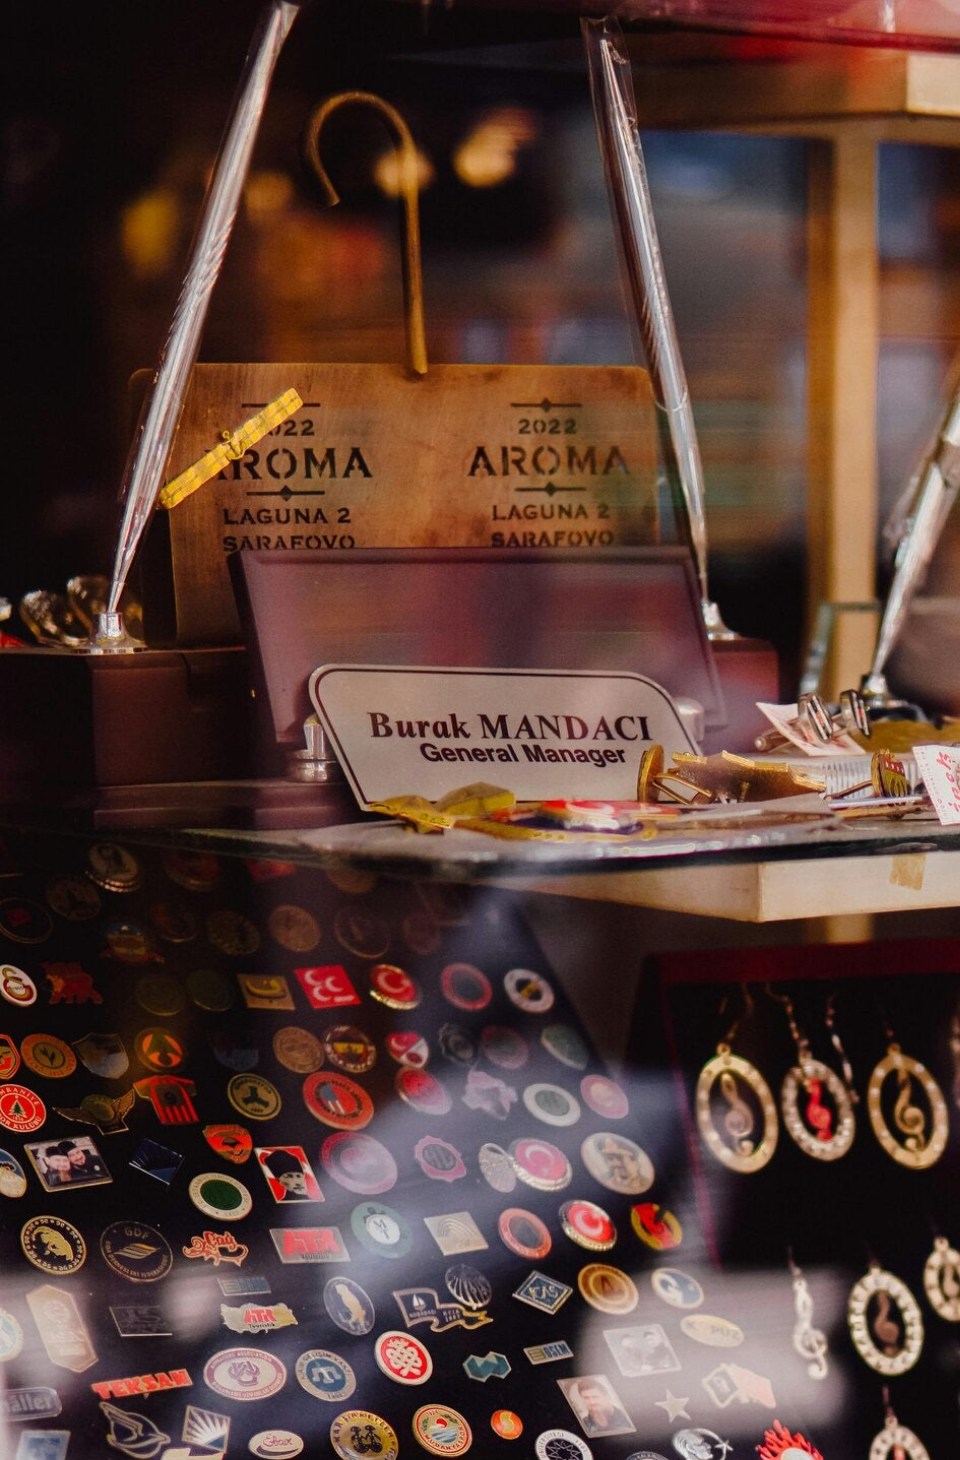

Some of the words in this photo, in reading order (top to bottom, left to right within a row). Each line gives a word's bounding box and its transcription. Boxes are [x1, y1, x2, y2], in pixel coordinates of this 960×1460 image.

[518, 418, 578, 435] 2022
[216, 446, 373, 481] ROMA
[467, 445, 631, 476] AROMA
[222, 508, 329, 525] LAGUNA
[337, 507, 351, 523] 2
[492, 504, 589, 521] LAGUNA
[597, 503, 611, 519] 2
[222, 535, 355, 551] SARAFOVO
[491, 530, 614, 548] SARAFOVO
[366, 711, 471, 738] Burak
[476, 713, 653, 741] MANDACI
[419, 743, 518, 763] General
[525, 744, 626, 767] Manager
[124, 1226, 149, 1239] GDF
[91, 1369, 192, 1400] TEKSAN
